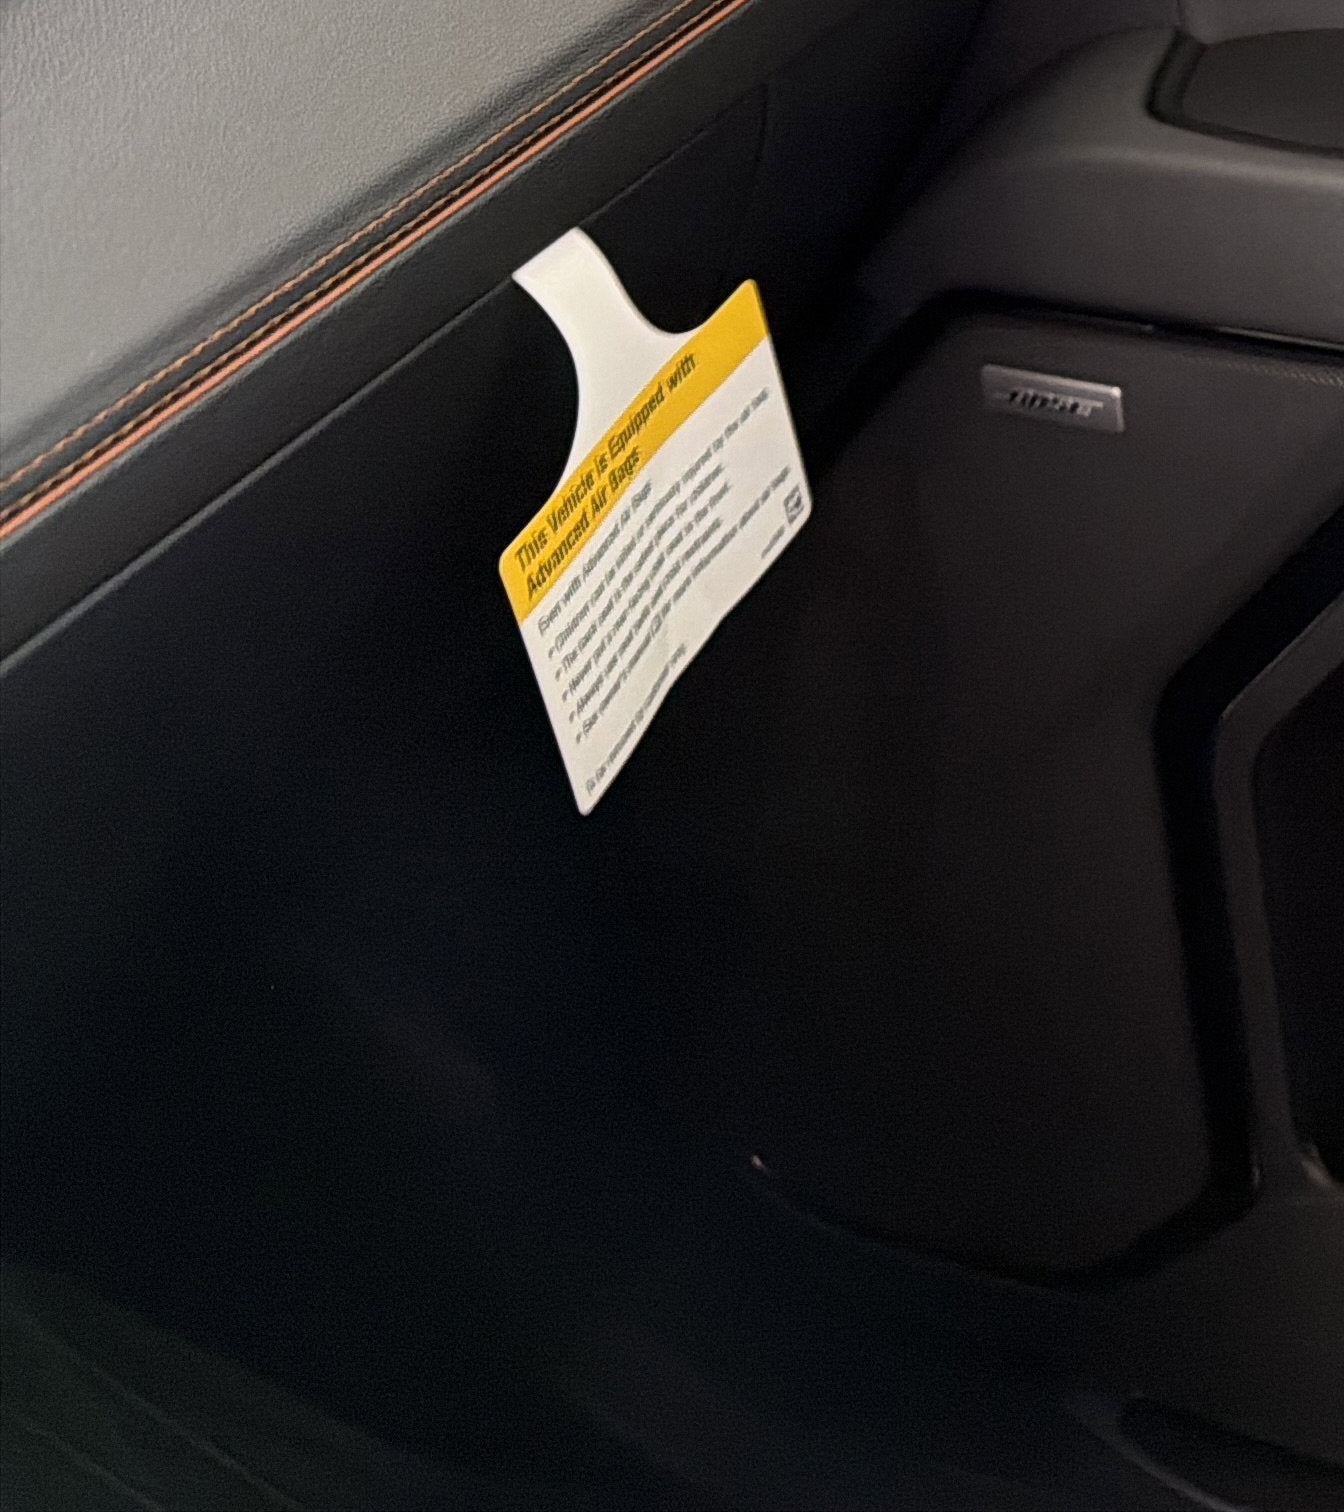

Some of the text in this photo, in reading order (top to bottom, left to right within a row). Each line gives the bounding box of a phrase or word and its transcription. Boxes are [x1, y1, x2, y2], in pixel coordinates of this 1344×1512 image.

[514, 525, 548, 572] This
[546, 466, 594, 533] Vehicle
[606, 380, 665, 461] Equipped
[664, 352, 696, 394] with
[527, 445, 639, 601] Advanced Air Bags
